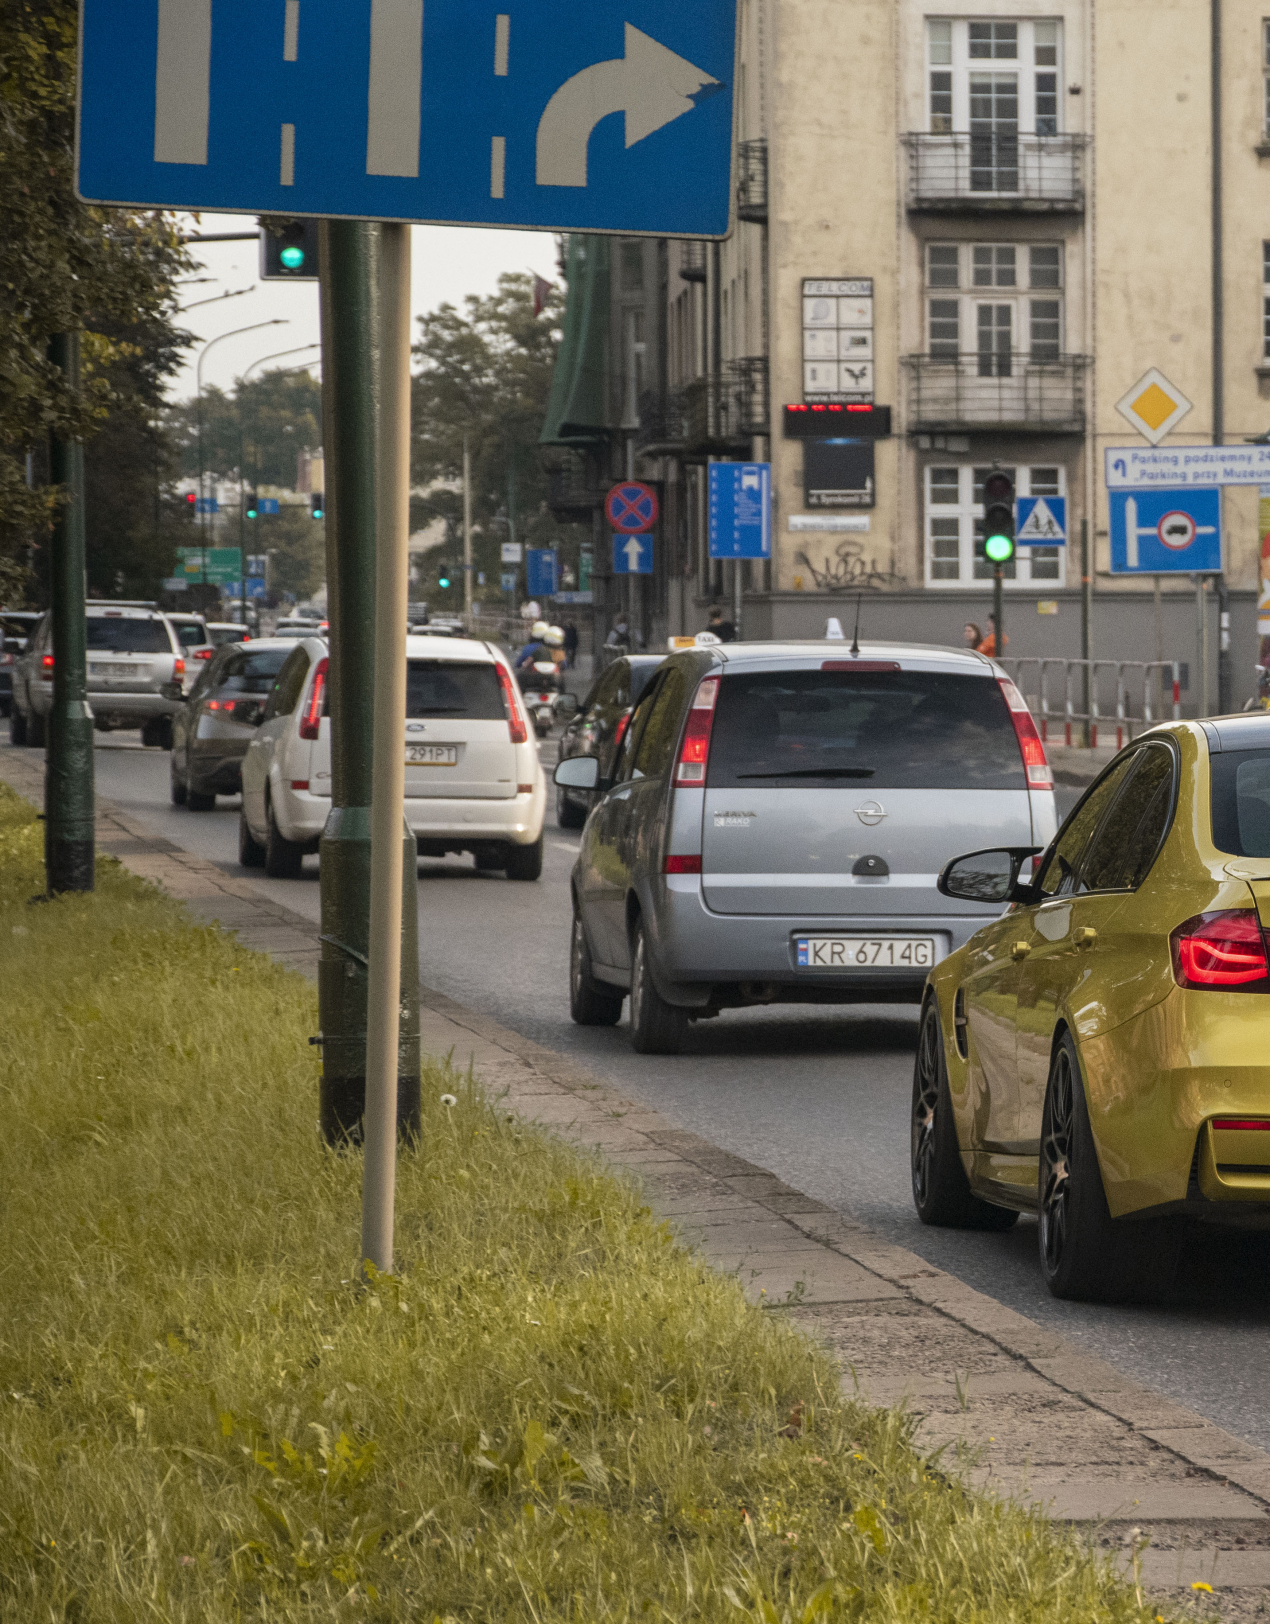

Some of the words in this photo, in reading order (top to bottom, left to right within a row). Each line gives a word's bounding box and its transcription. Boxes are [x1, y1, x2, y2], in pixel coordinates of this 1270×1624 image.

[805, 282, 871, 293] TELCOM
[1131, 453, 1179, 466] Parking
[1184, 451, 1253, 465] podziemny
[1193, 470, 1218, 481] przy
[409, 747, 453, 761] 291PT
[813, 942, 845, 964] KR
[855, 942, 928, 965] 6714G
